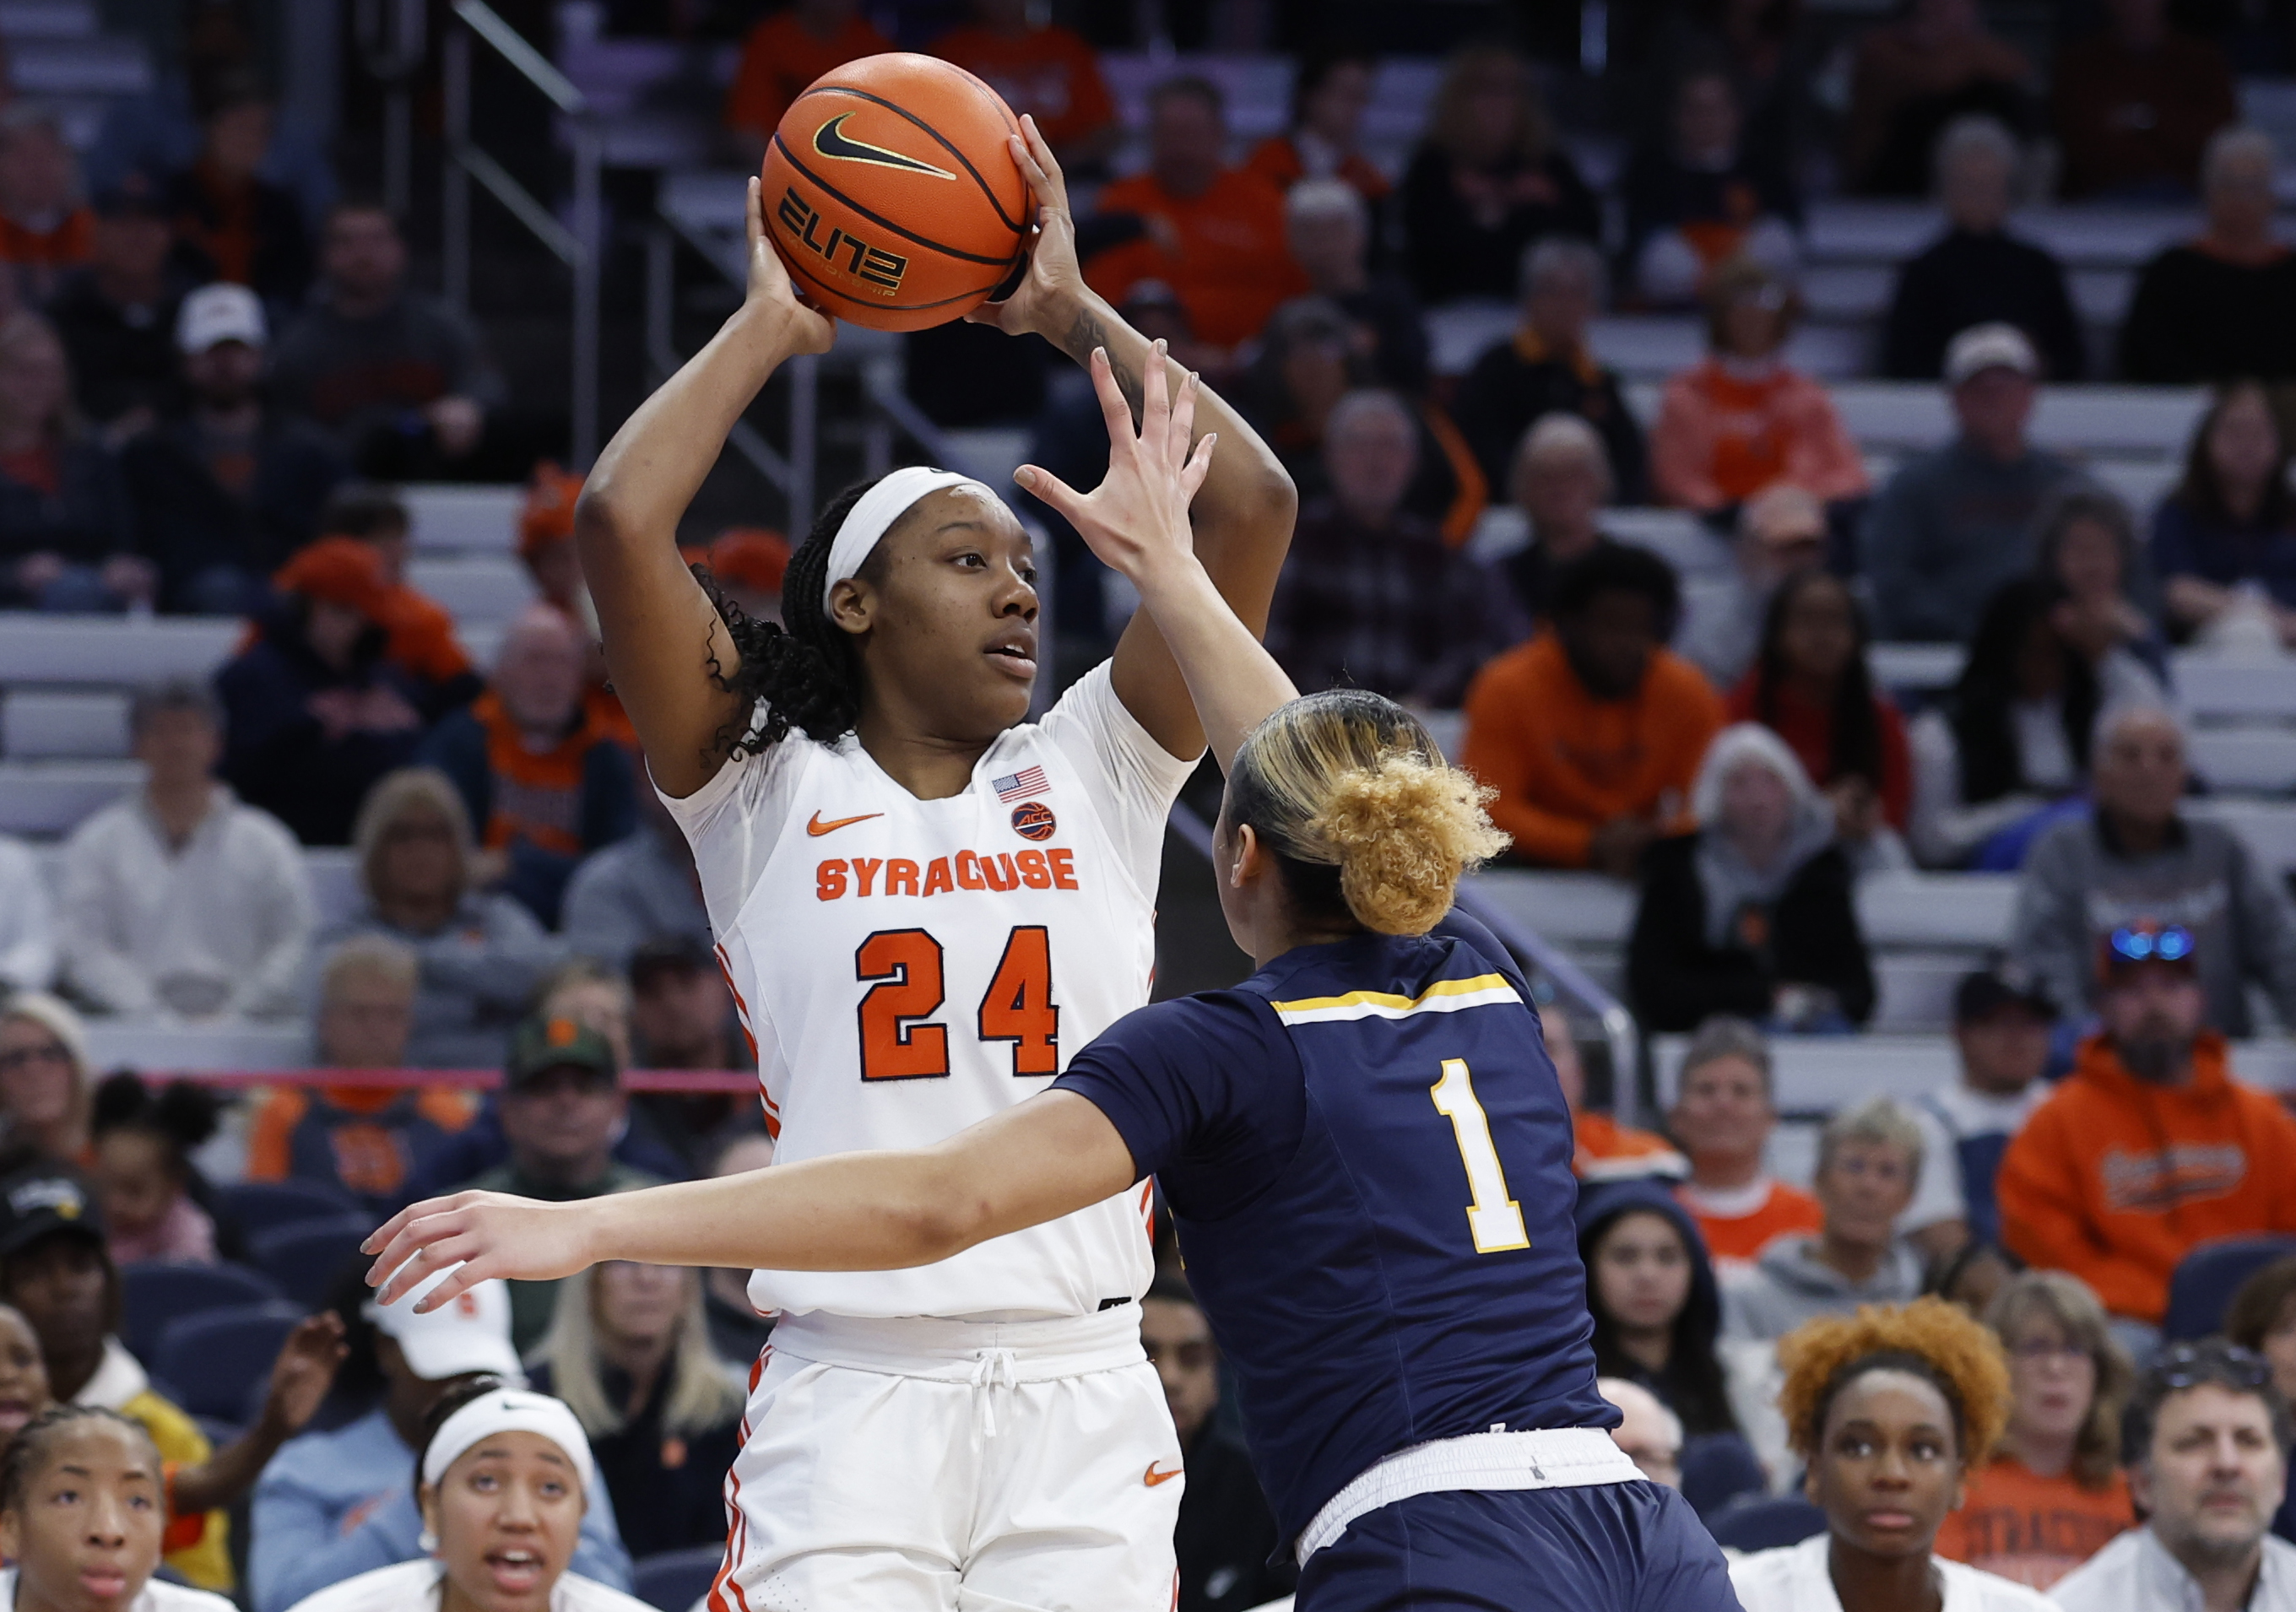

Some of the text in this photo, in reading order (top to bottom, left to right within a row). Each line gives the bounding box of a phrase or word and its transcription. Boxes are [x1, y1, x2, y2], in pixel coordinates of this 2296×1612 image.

[777, 186, 908, 290] ELITE
[1017, 811, 1053, 826] ACC
[816, 848, 1079, 901] SYRACUSE
[855, 925, 1059, 1081] 24
[1430, 1058, 1531, 1254] 1
